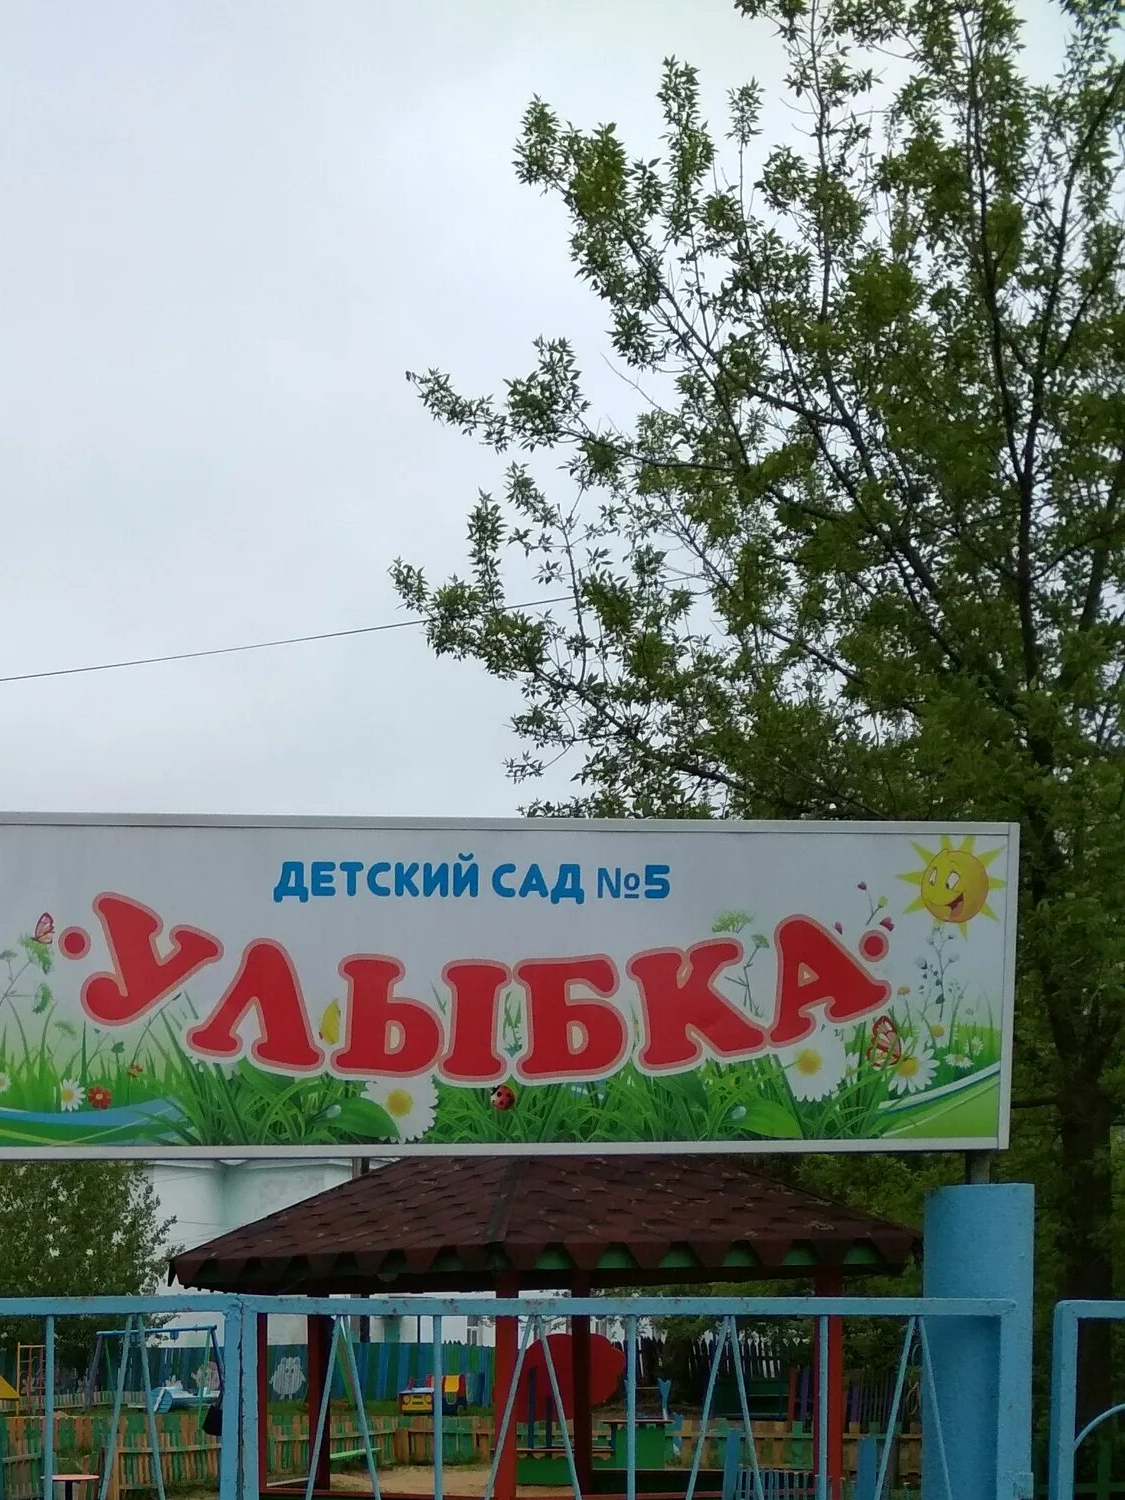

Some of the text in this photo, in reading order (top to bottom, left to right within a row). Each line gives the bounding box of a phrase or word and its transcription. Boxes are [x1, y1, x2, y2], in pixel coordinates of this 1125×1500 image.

[273, 852, 671, 905] ДЕТСКИЙ САД №5
[79, 891, 893, 1083] УЛЫБКА
